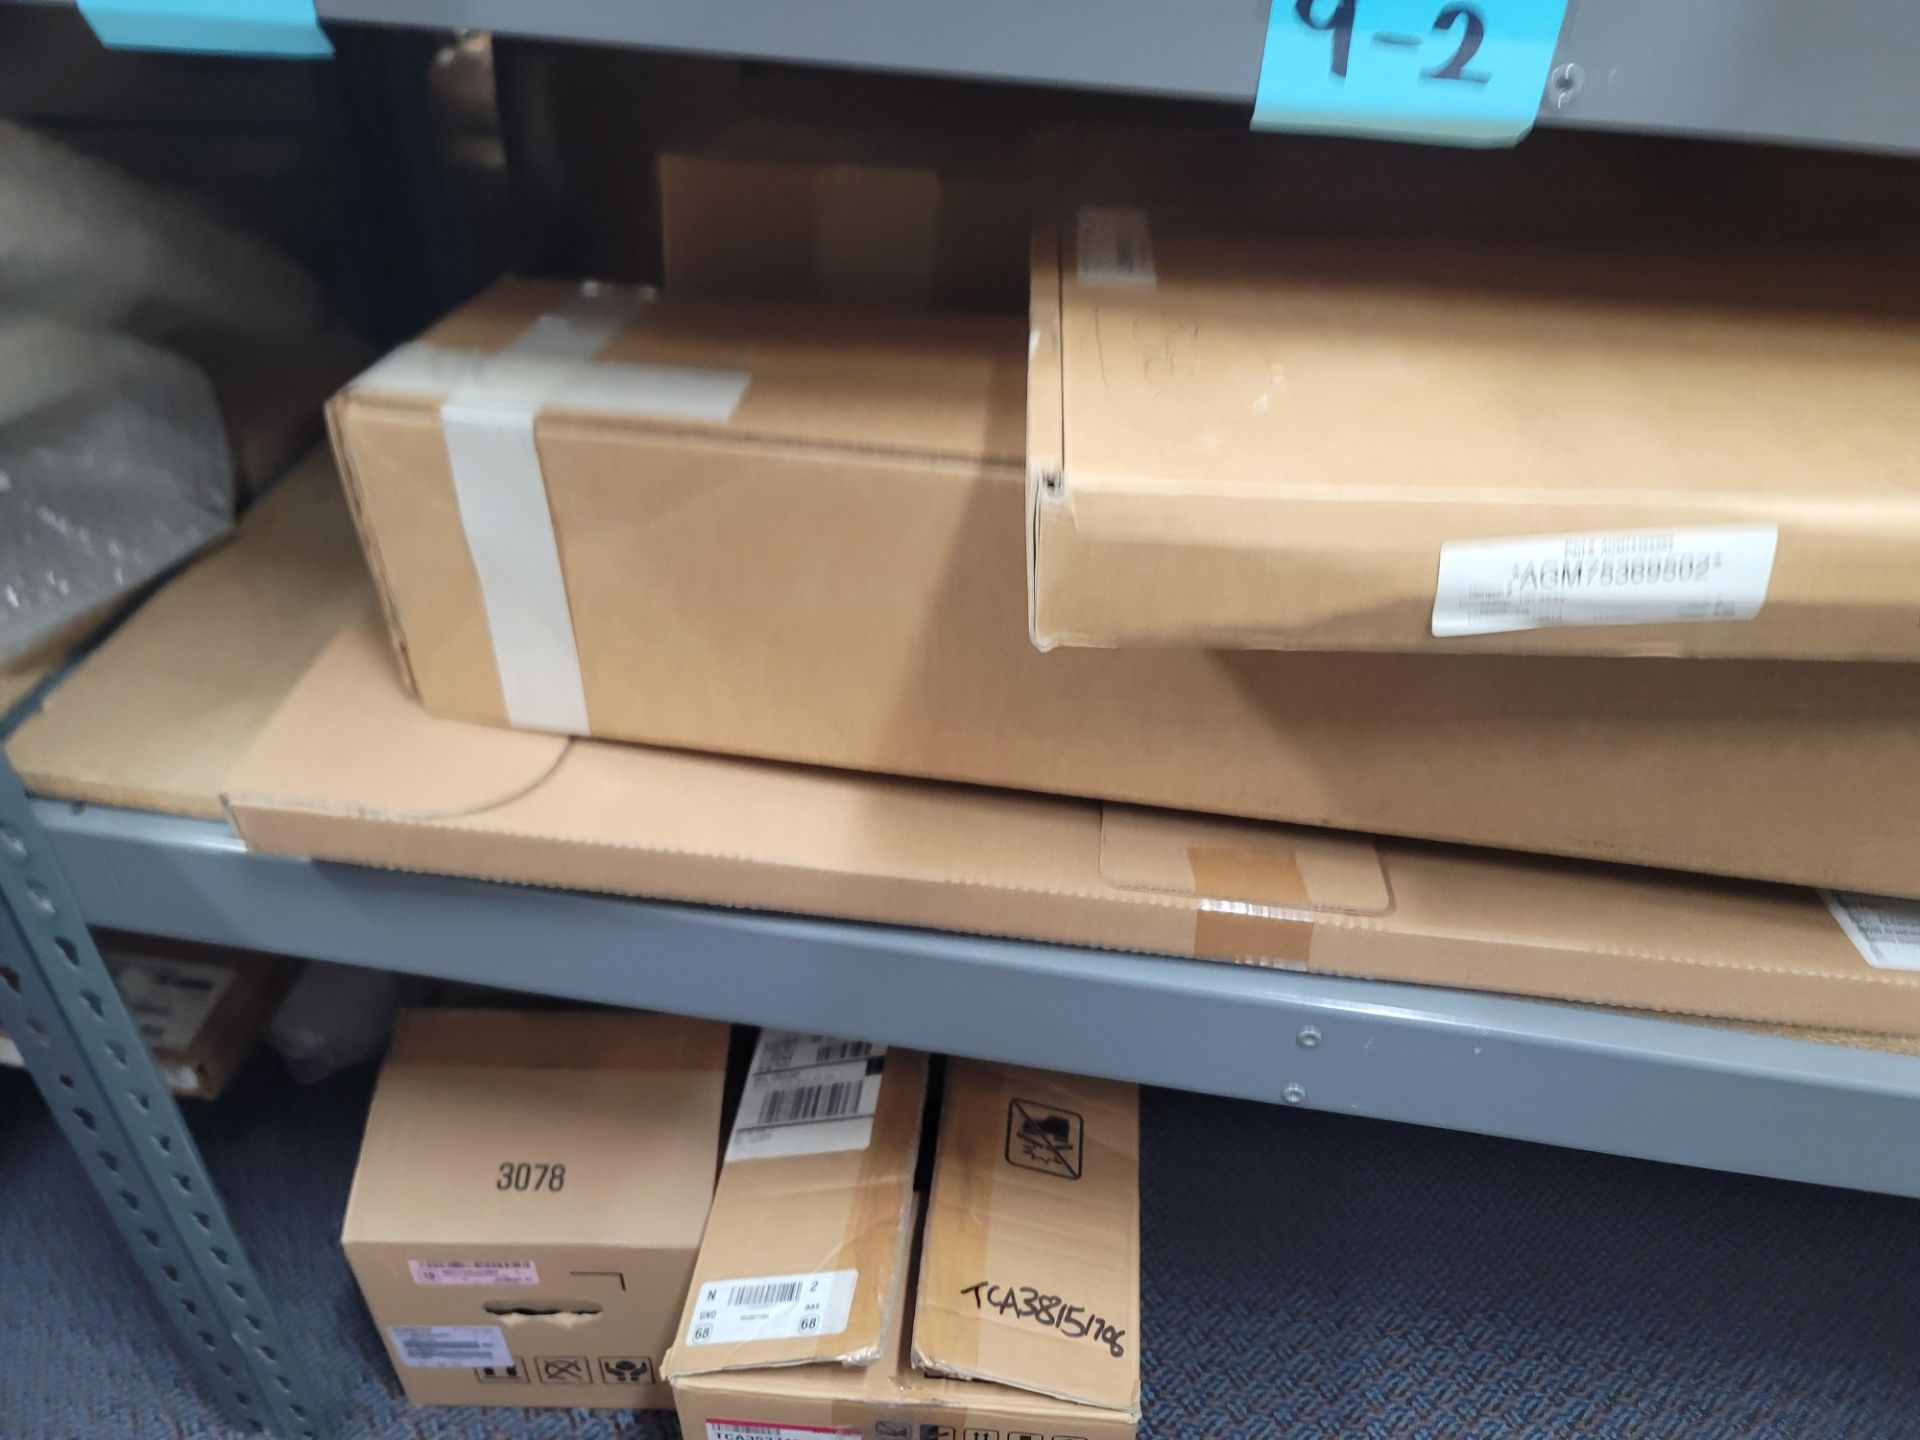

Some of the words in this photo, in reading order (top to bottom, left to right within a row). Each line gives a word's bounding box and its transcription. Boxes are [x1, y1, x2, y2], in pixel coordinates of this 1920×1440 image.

[1295, 0, 1492, 83] 9-2
[497, 1162, 566, 1191] 3078
[810, 1280, 819, 1292] 2
[707, 1289, 717, 1301] N
[801, 1317, 817, 1330] 68
[694, 1327, 710, 1339] 68
